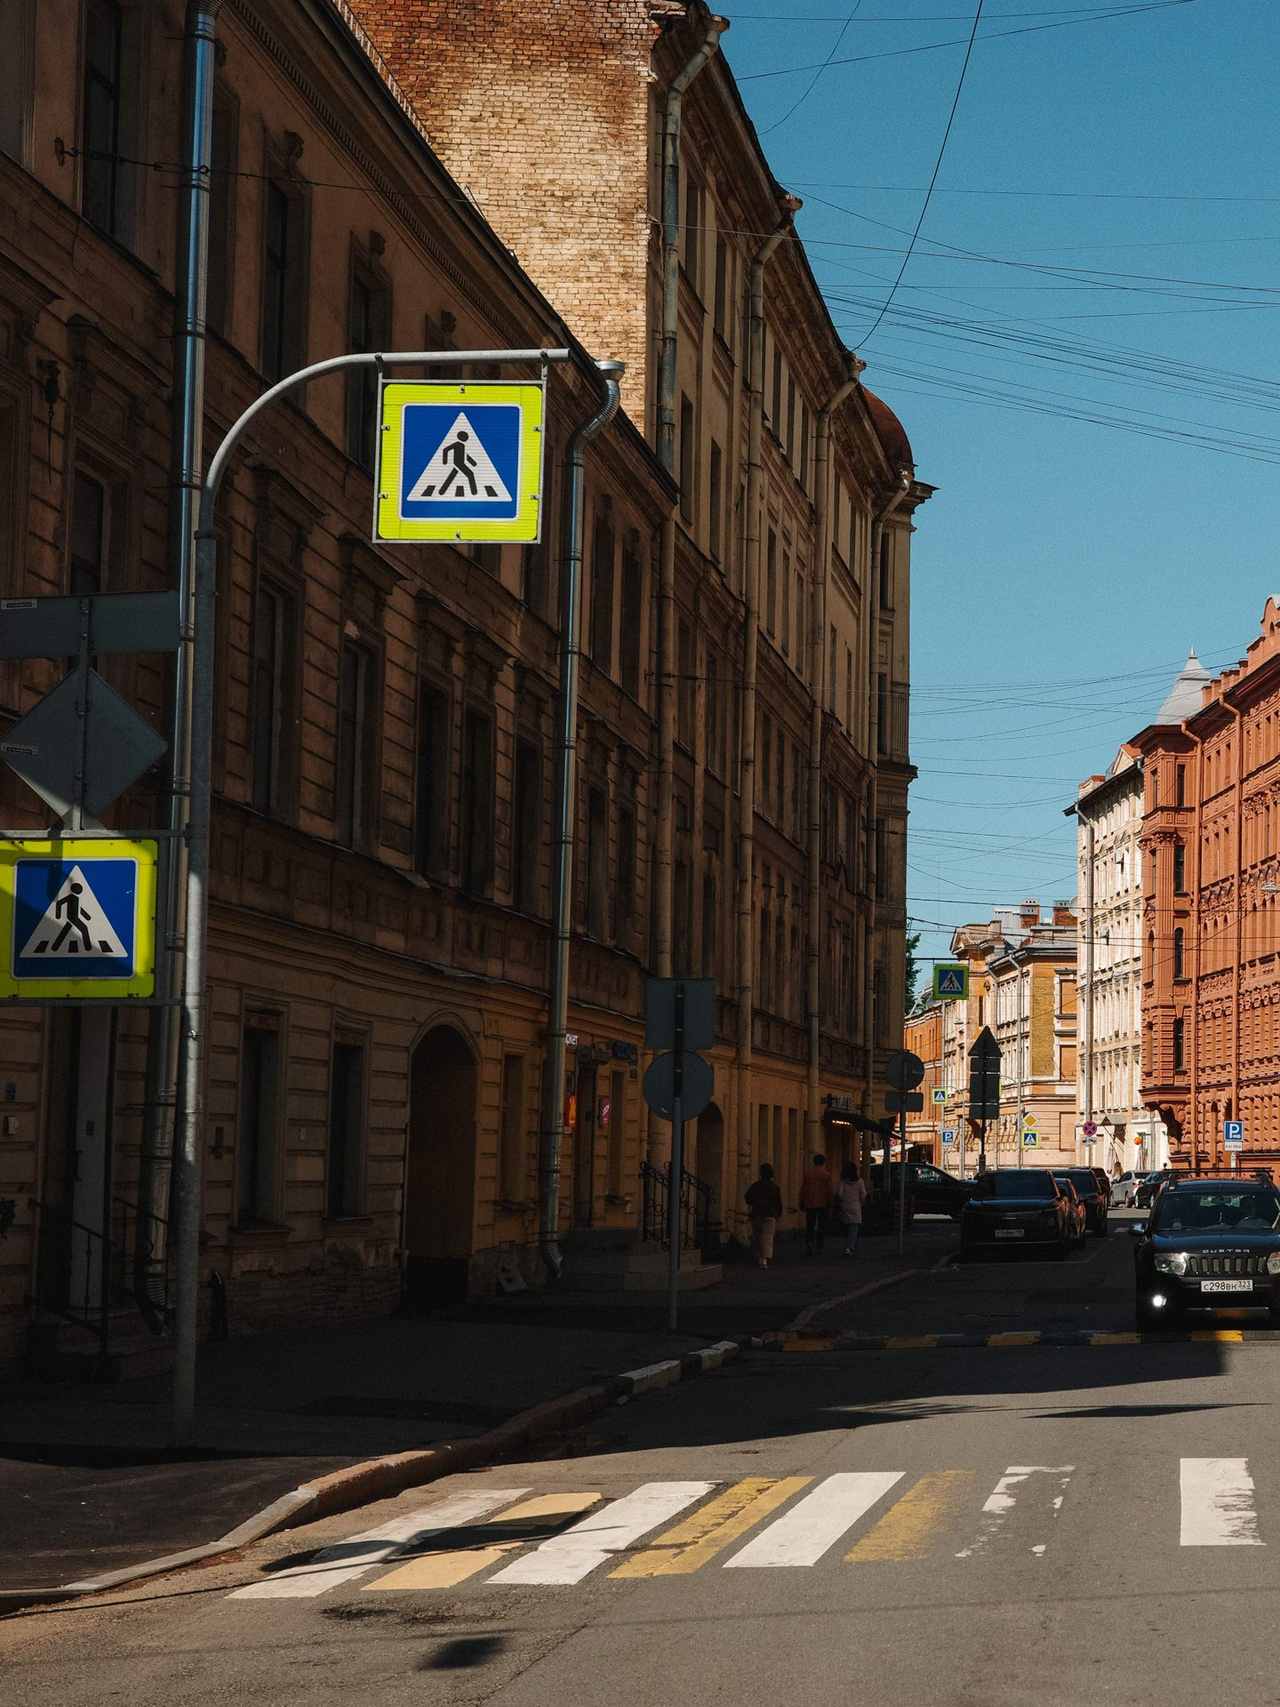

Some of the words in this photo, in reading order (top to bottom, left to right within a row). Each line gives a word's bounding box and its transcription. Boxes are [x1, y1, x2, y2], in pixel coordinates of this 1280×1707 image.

[1229, 1123, 1240, 1138] P
[1203, 1281, 1237, 1291] С298ВН
[1238, 1280, 1251, 1288] 323
